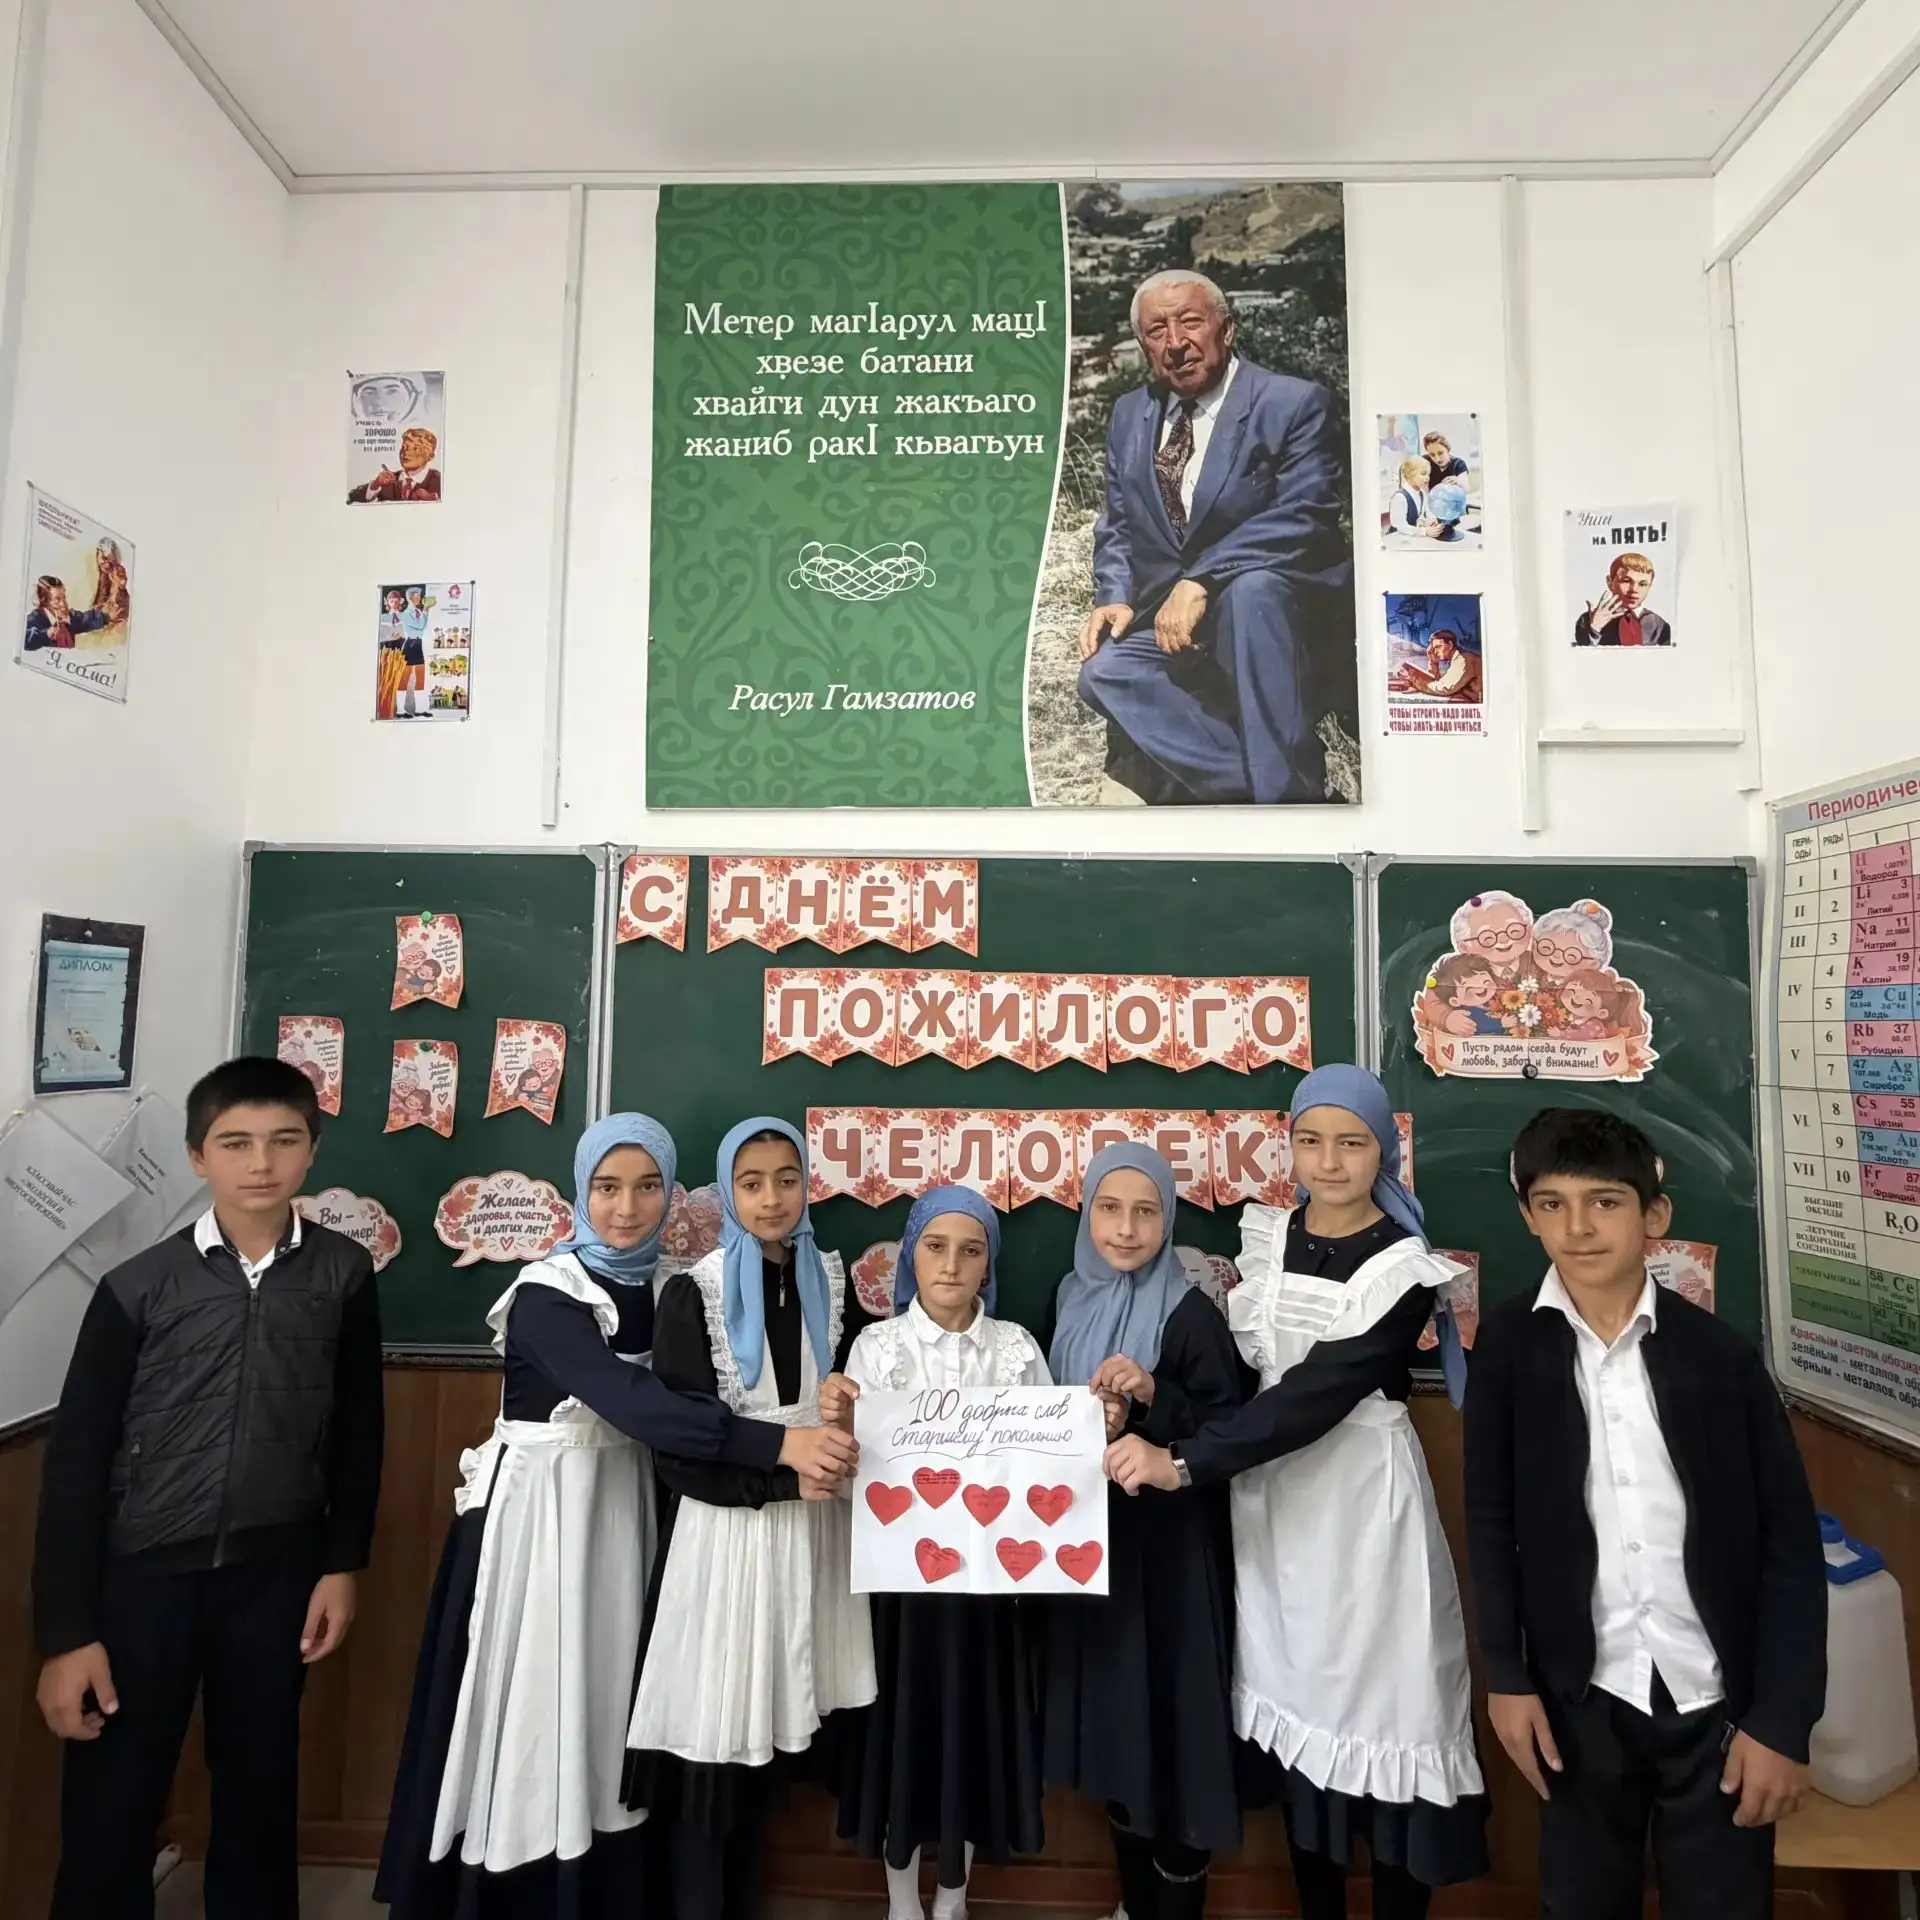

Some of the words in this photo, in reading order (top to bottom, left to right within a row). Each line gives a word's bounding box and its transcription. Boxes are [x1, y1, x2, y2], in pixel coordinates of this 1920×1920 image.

[684, 302, 794, 341] Метер
[860, 347, 974, 374] батани
[693, 385, 803, 416] хвайги
[818, 395, 879, 422] дун
[894, 393, 1036, 415] жакъаго
[364, 428, 397, 437] ХОРОШО
[684, 429, 793, 457] жаниб
[895, 434, 1045, 462] кьвагьун
[1611, 521, 1667, 545] ПЯТЬ!
[46, 650, 62, 669] Я
[66, 662, 117, 688] сама!
[728, 684, 814, 718] Расул
[821, 684, 977, 711] Гамзатов
[1389, 708, 1411, 719] ЧТОБЫ
[1389, 721, 1412, 732] ЧТОБЫ
[1808, 779, 1920, 821] Периодиче
[1823, 833, 1844, 846] РЯДЫ
[1794, 849, 1811, 860] ОДЫ
[1900, 846, 1905, 855] 1
[1856, 884, 1871, 899] Li
[1900, 878, 1908, 889] 3
[629, 875, 675, 923] С
[721, 875, 964, 929] ДНЁМ
[1831, 900, 1839, 913] 2
[1856, 921, 1877, 937] Na
[1896, 916, 1908, 927] 11
[1790, 935, 1806, 948] III
[1830, 933, 1838, 945] 3
[1863, 940, 1897, 952] Натрий
[59, 960, 113, 973] ДИПЛОМ
[1854, 955, 1866, 970] K
[1896, 952, 1910, 963] 19
[1827, 965, 1834, 977] 4
[1788, 984, 1802, 997] IV
[1850, 989, 1863, 1000] 29
[1884, 988, 1907, 1001] Cu
[1825, 998, 1832, 1010] 5
[779, 987, 1297, 1049] ПОЖИЛОГО
[1864, 1010, 1889, 1019] Медь
[1826, 1031, 1833, 1043] 6
[1853, 1023, 1874, 1037] Rb
[1894, 1023, 1909, 1034] 37
[1462, 1041, 1490, 1055] Пусть
[1493, 1043, 1523, 1056] рядом
[1560, 1043, 1588, 1056] будут
[1791, 1049, 1800, 1061] V
[1861, 1046, 1904, 1056] Рубидий
[429, 1061, 450, 1070] Забота
[1461, 1055, 1499, 1067] любовь,
[1502, 1055, 1533, 1068] забот
[1535, 1058, 1542, 1067] и
[1546, 1055, 1599, 1068] внимание!
[1853, 1059, 1867, 1069] 47
[1890, 1060, 1913, 1076] Ag
[1828, 1063, 1834, 1076] 7
[1832, 1102, 1841, 1116] 8
[1856, 1095, 1877, 1109] Cs
[1900, 1098, 1915, 1109] 55
[1792, 1113, 1810, 1127] VI
[1836, 1136, 1844, 1149] 9
[1860, 1131, 1874, 1142] 79
[1897, 1133, 1919, 1148] Au
[821, 1128, 1299, 1184] ЧЕЛОЕК
[1874, 1153, 1909, 1165] Золото
[1793, 1162, 1815, 1176] VII
[1863, 1164, 1881, 1180] Fr
[1906, 1172, 1920, 1183] 87
[1836, 1170, 1851, 1184] 10
[26, 1165, 64, 1197] КЛАССНЫЙ
[62, 1193, 78, 1208] ЧАС
[479, 1194, 536, 1210] Желаем
[1804, 1196, 1843, 1209] ВЫСШИЕ
[319, 1207, 343, 1226] Вы
[1805, 1205, 1843, 1218] ОКСИДЫ
[464, 1211, 513, 1227] здоровья,
[515, 1211, 552, 1222] счастья
[474, 1226, 480, 1236] и
[483, 1224, 522, 1237] долгих
[524, 1224, 550, 1237] лет!
[1806, 1225, 1846, 1240] ЛЕТУЧИЕ
[1796, 1232, 1857, 1251] ВОДОРОДНЫЕ
[1796, 1241, 1857, 1260] СОЕДИНЕНИЯ
[1870, 1270, 1883, 1282] 58
[1893, 1276, 1914, 1294] Ce
[1790, 1325, 1838, 1348] Красным
[1841, 1340, 1880, 1360] цветом
[1881, 1353, 1920, 1375] обозна
[1791, 1341, 1838, 1363] зелёным
[1791, 1355, 1832, 1377] чёрным
[909, 1389, 960, 1425] 100
[1034, 1393, 1071, 1420] слов
[990, 1429, 1073, 1444] поколению
